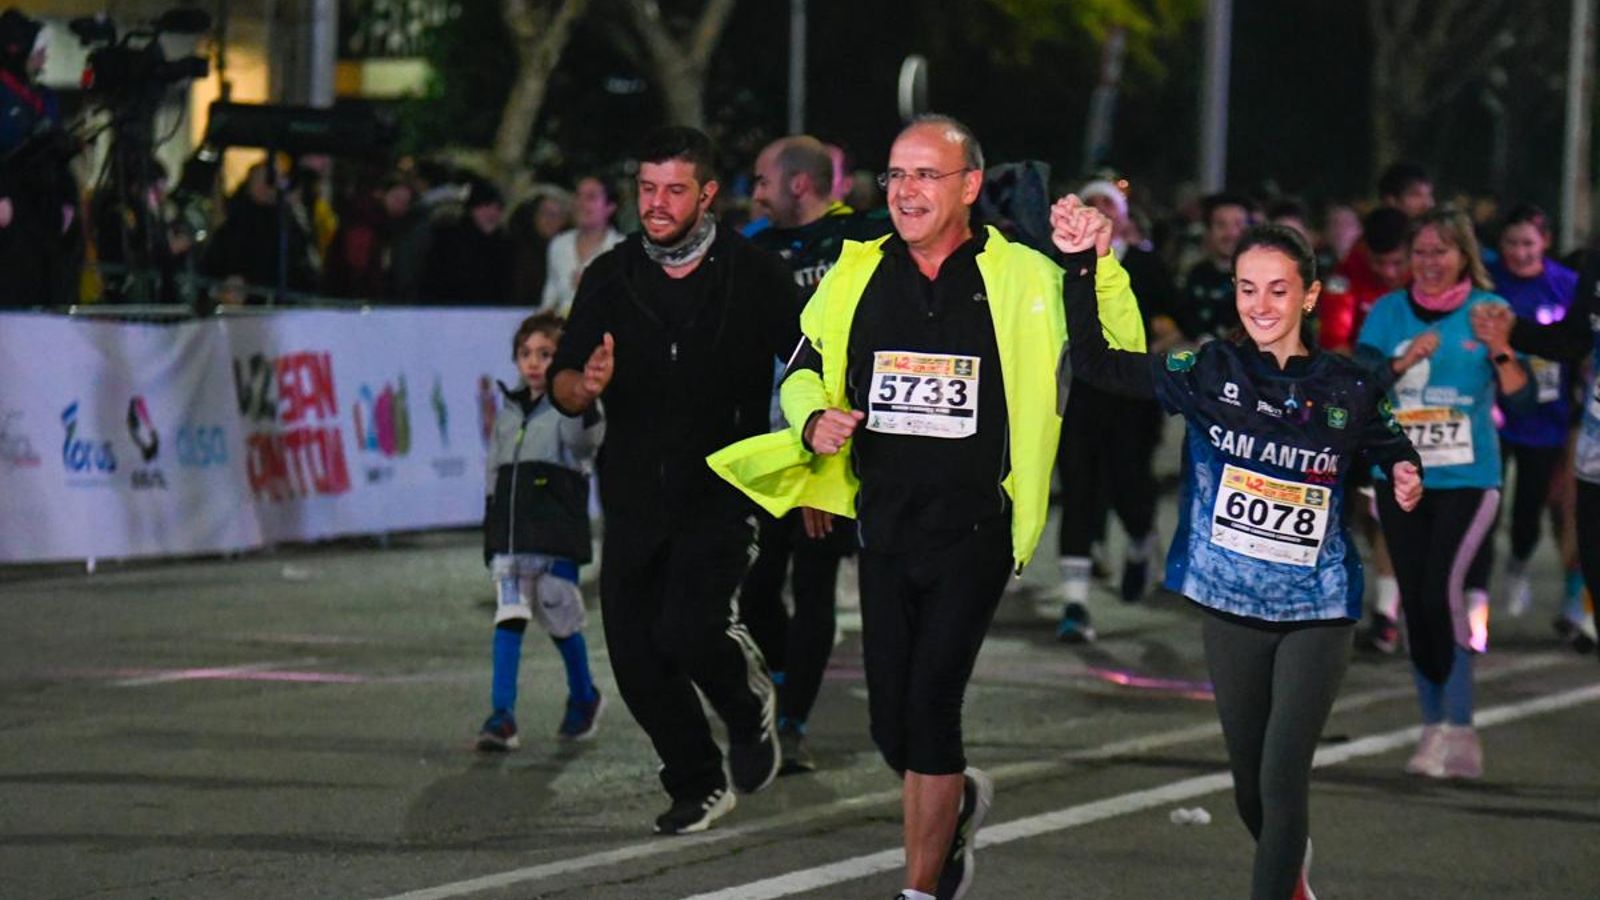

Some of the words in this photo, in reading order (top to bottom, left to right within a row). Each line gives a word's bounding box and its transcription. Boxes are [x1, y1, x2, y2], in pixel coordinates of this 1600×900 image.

[276, 351, 338, 423] SAN
[879, 375, 967, 406] 5733
[1209, 424, 1255, 459] SAN
[1226, 491, 1317, 536] 6078
